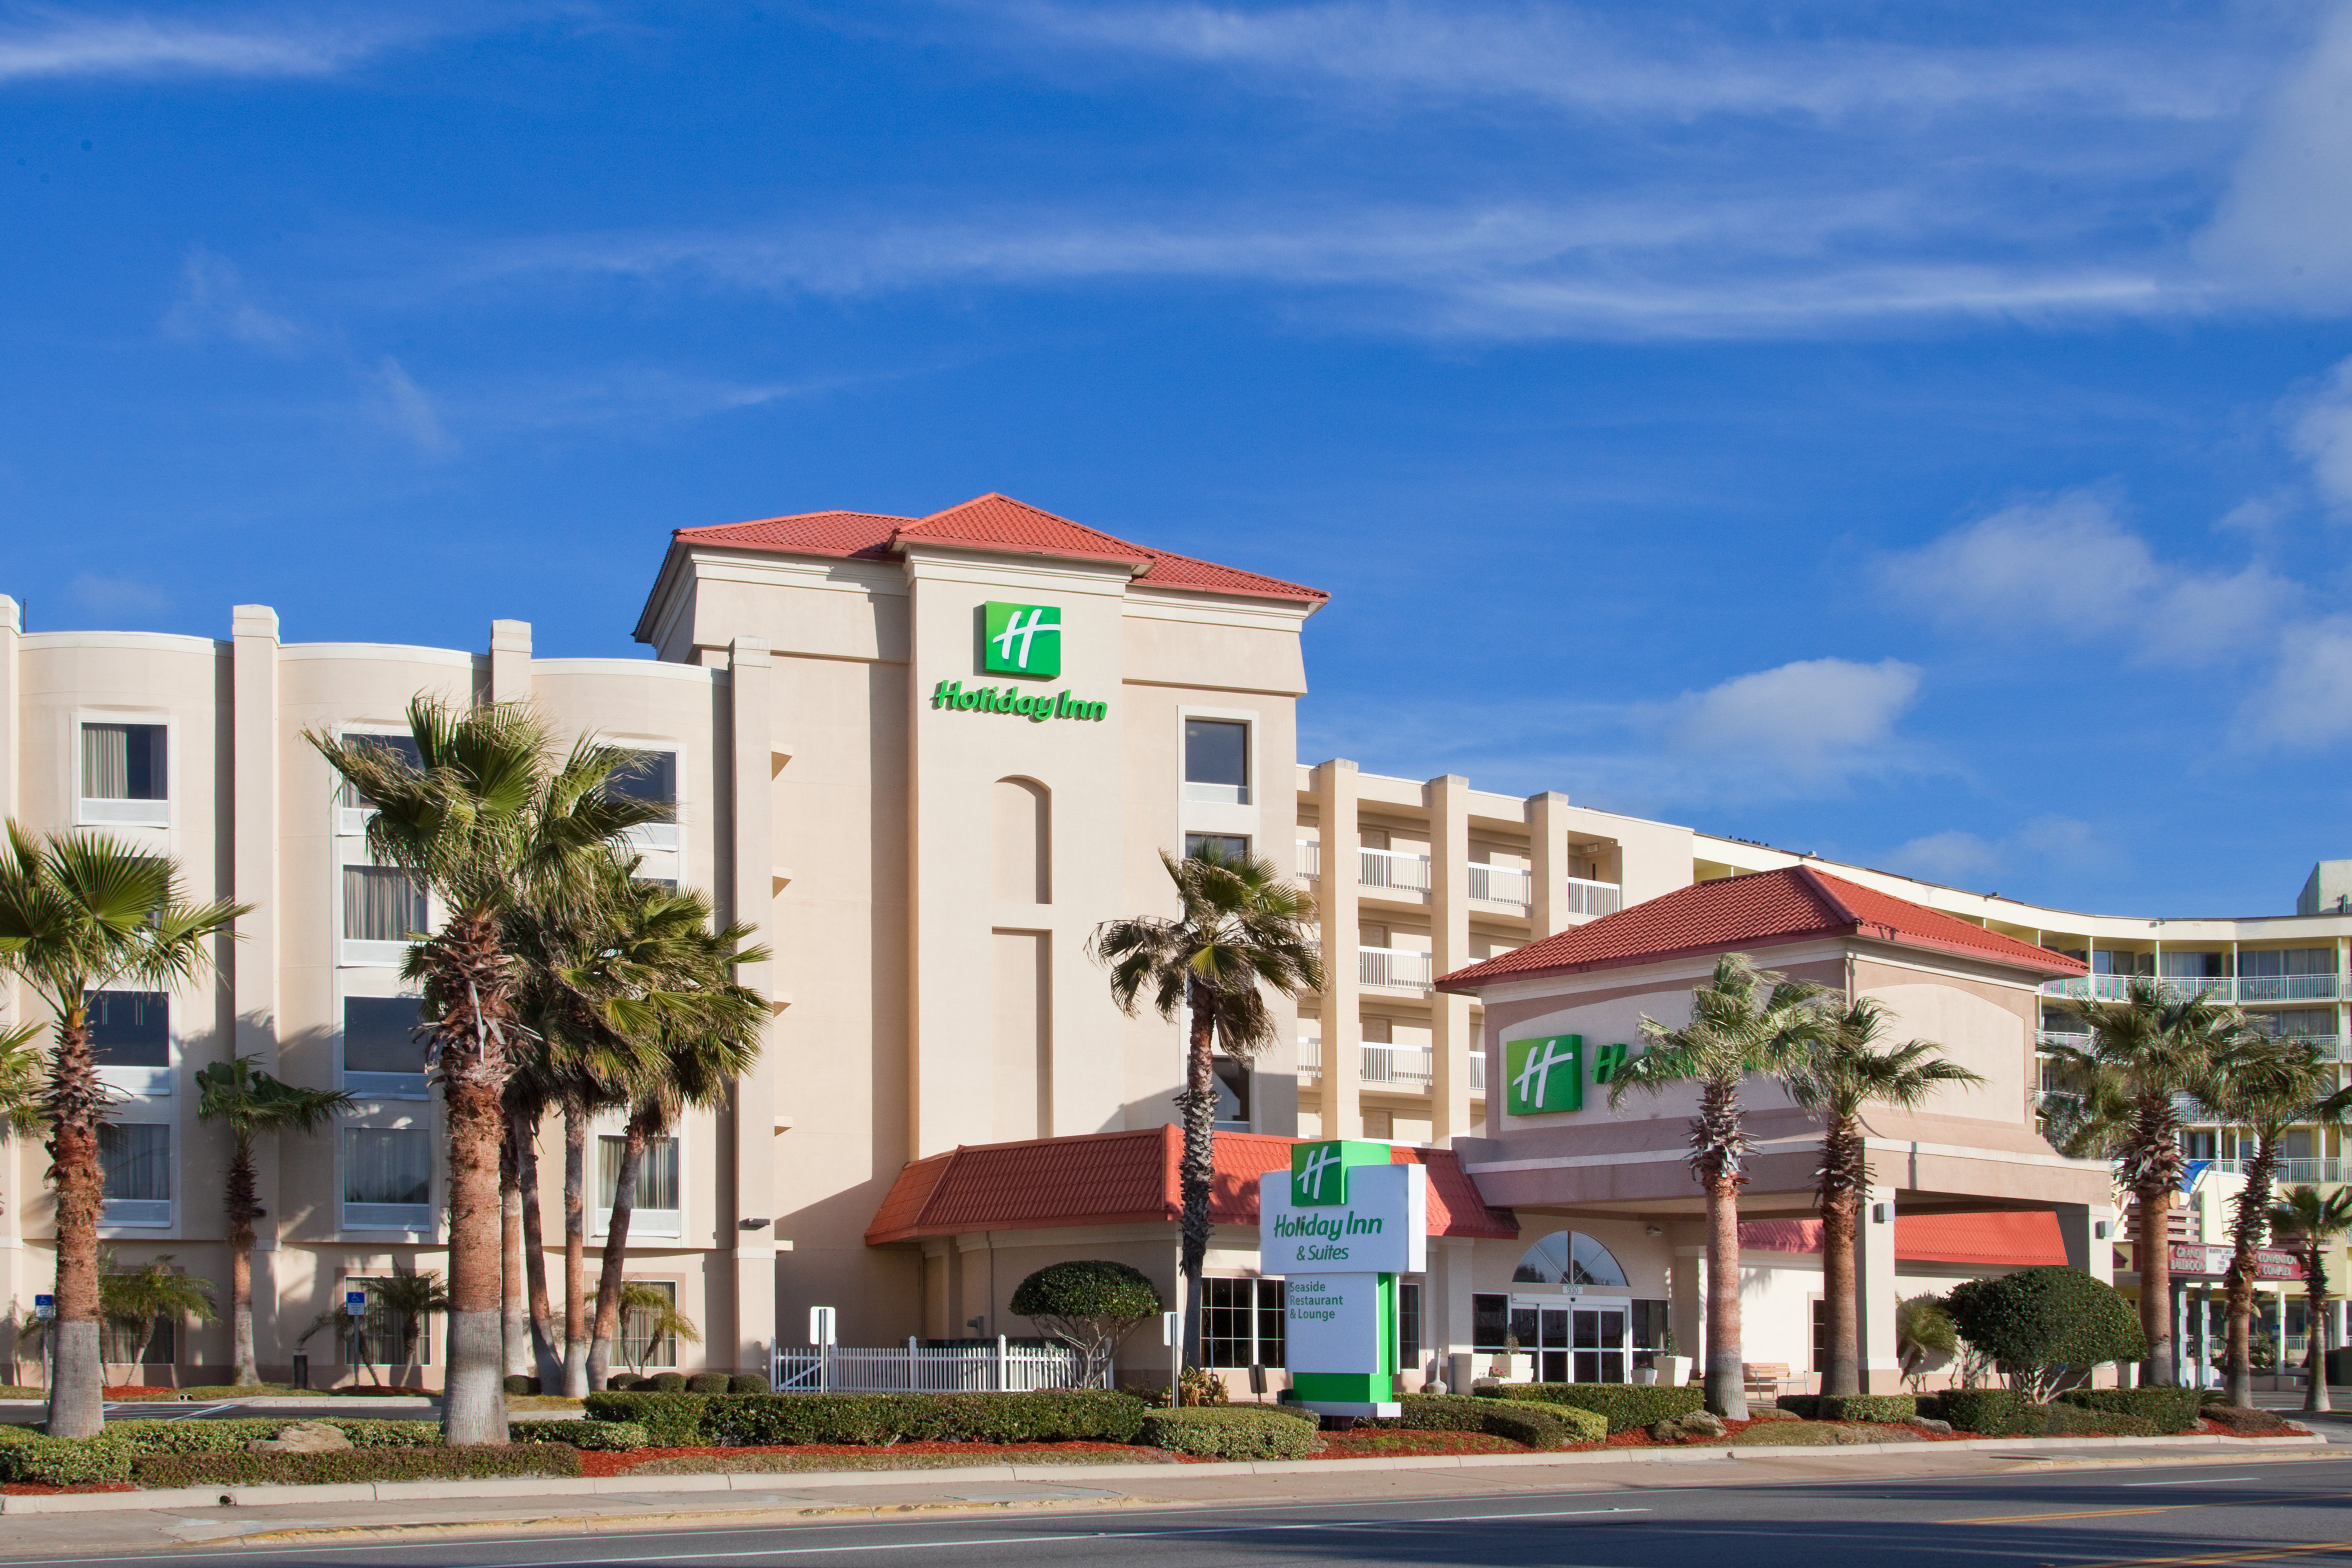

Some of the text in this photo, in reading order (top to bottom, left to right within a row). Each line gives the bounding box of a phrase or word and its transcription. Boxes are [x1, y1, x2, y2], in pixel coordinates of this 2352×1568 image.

[993, 609, 1061, 668] H
[936, 679, 1108, 720] Holiday Inn
[1513, 1040, 1573, 1108] H
[1297, 1145, 1341, 1200] H
[1274, 1210, 1383, 1241] Holiday Inn
[1296, 1245, 1349, 1261] & Suites
[2176, 1247, 2200, 1259] GRAND
[2257, 1253, 2297, 1265] CONVENTION
[2171, 1259, 2207, 1272] BALLROOM
[2263, 1265, 2292, 1276] COMPLEX
[1290, 1281, 1326, 1292] Seaside
[1290, 1295, 1343, 1305] Restaurant
[1290, 1308, 1335, 1322] & Lounge
